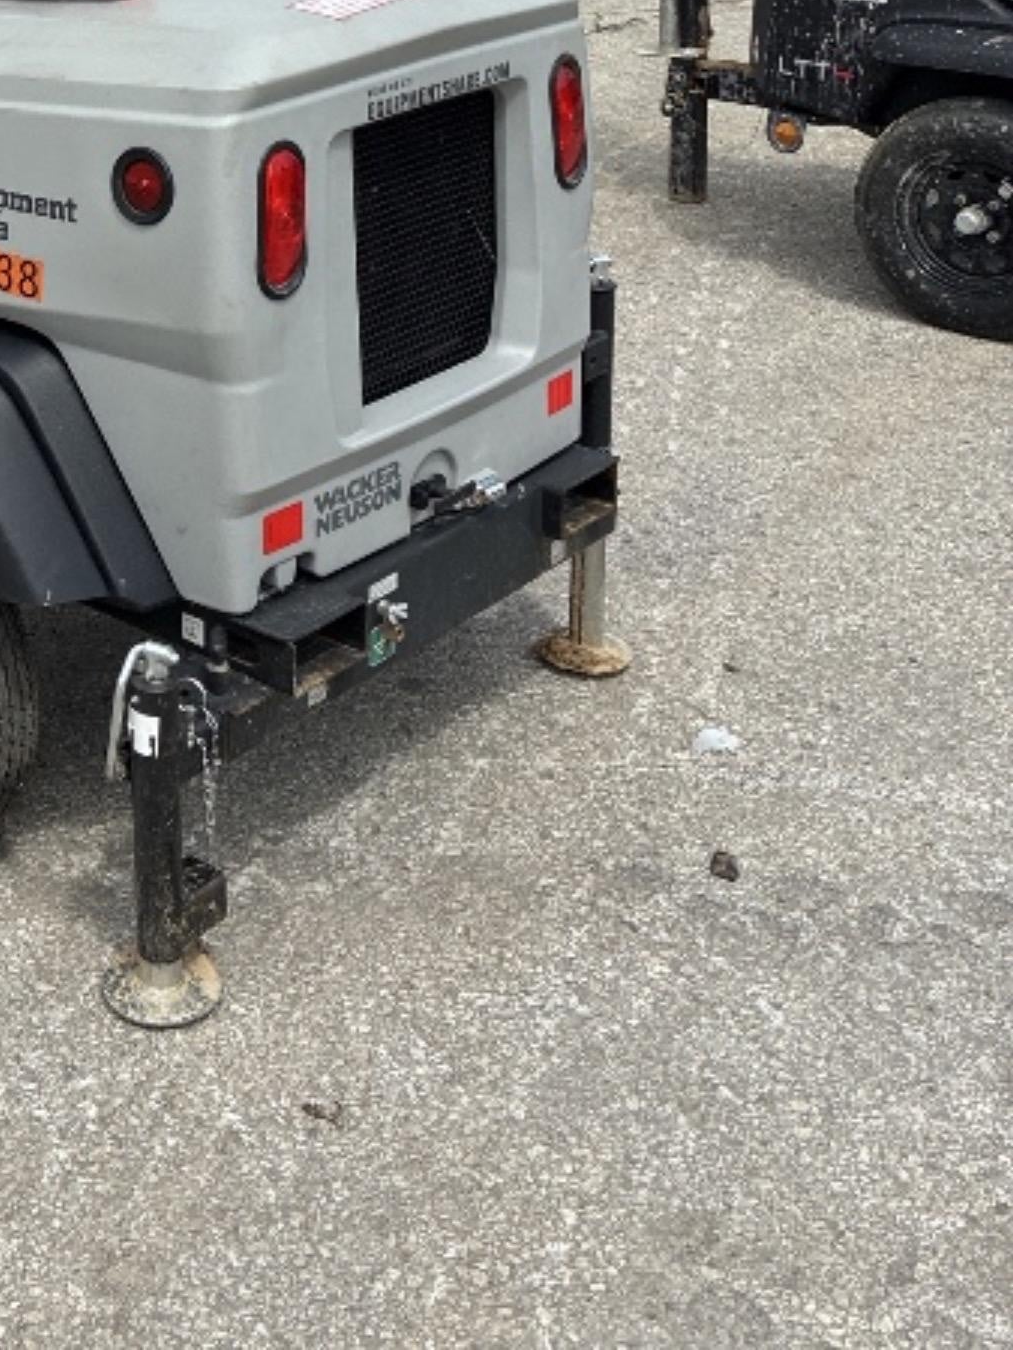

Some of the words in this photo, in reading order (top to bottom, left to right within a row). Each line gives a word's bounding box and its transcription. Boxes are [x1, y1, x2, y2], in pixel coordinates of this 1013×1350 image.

[367, 60, 510, 122] EQUIPMENTSHARE.COM
[313, 461, 402, 515] WACKER
[315, 480, 403, 538] NEUSON
